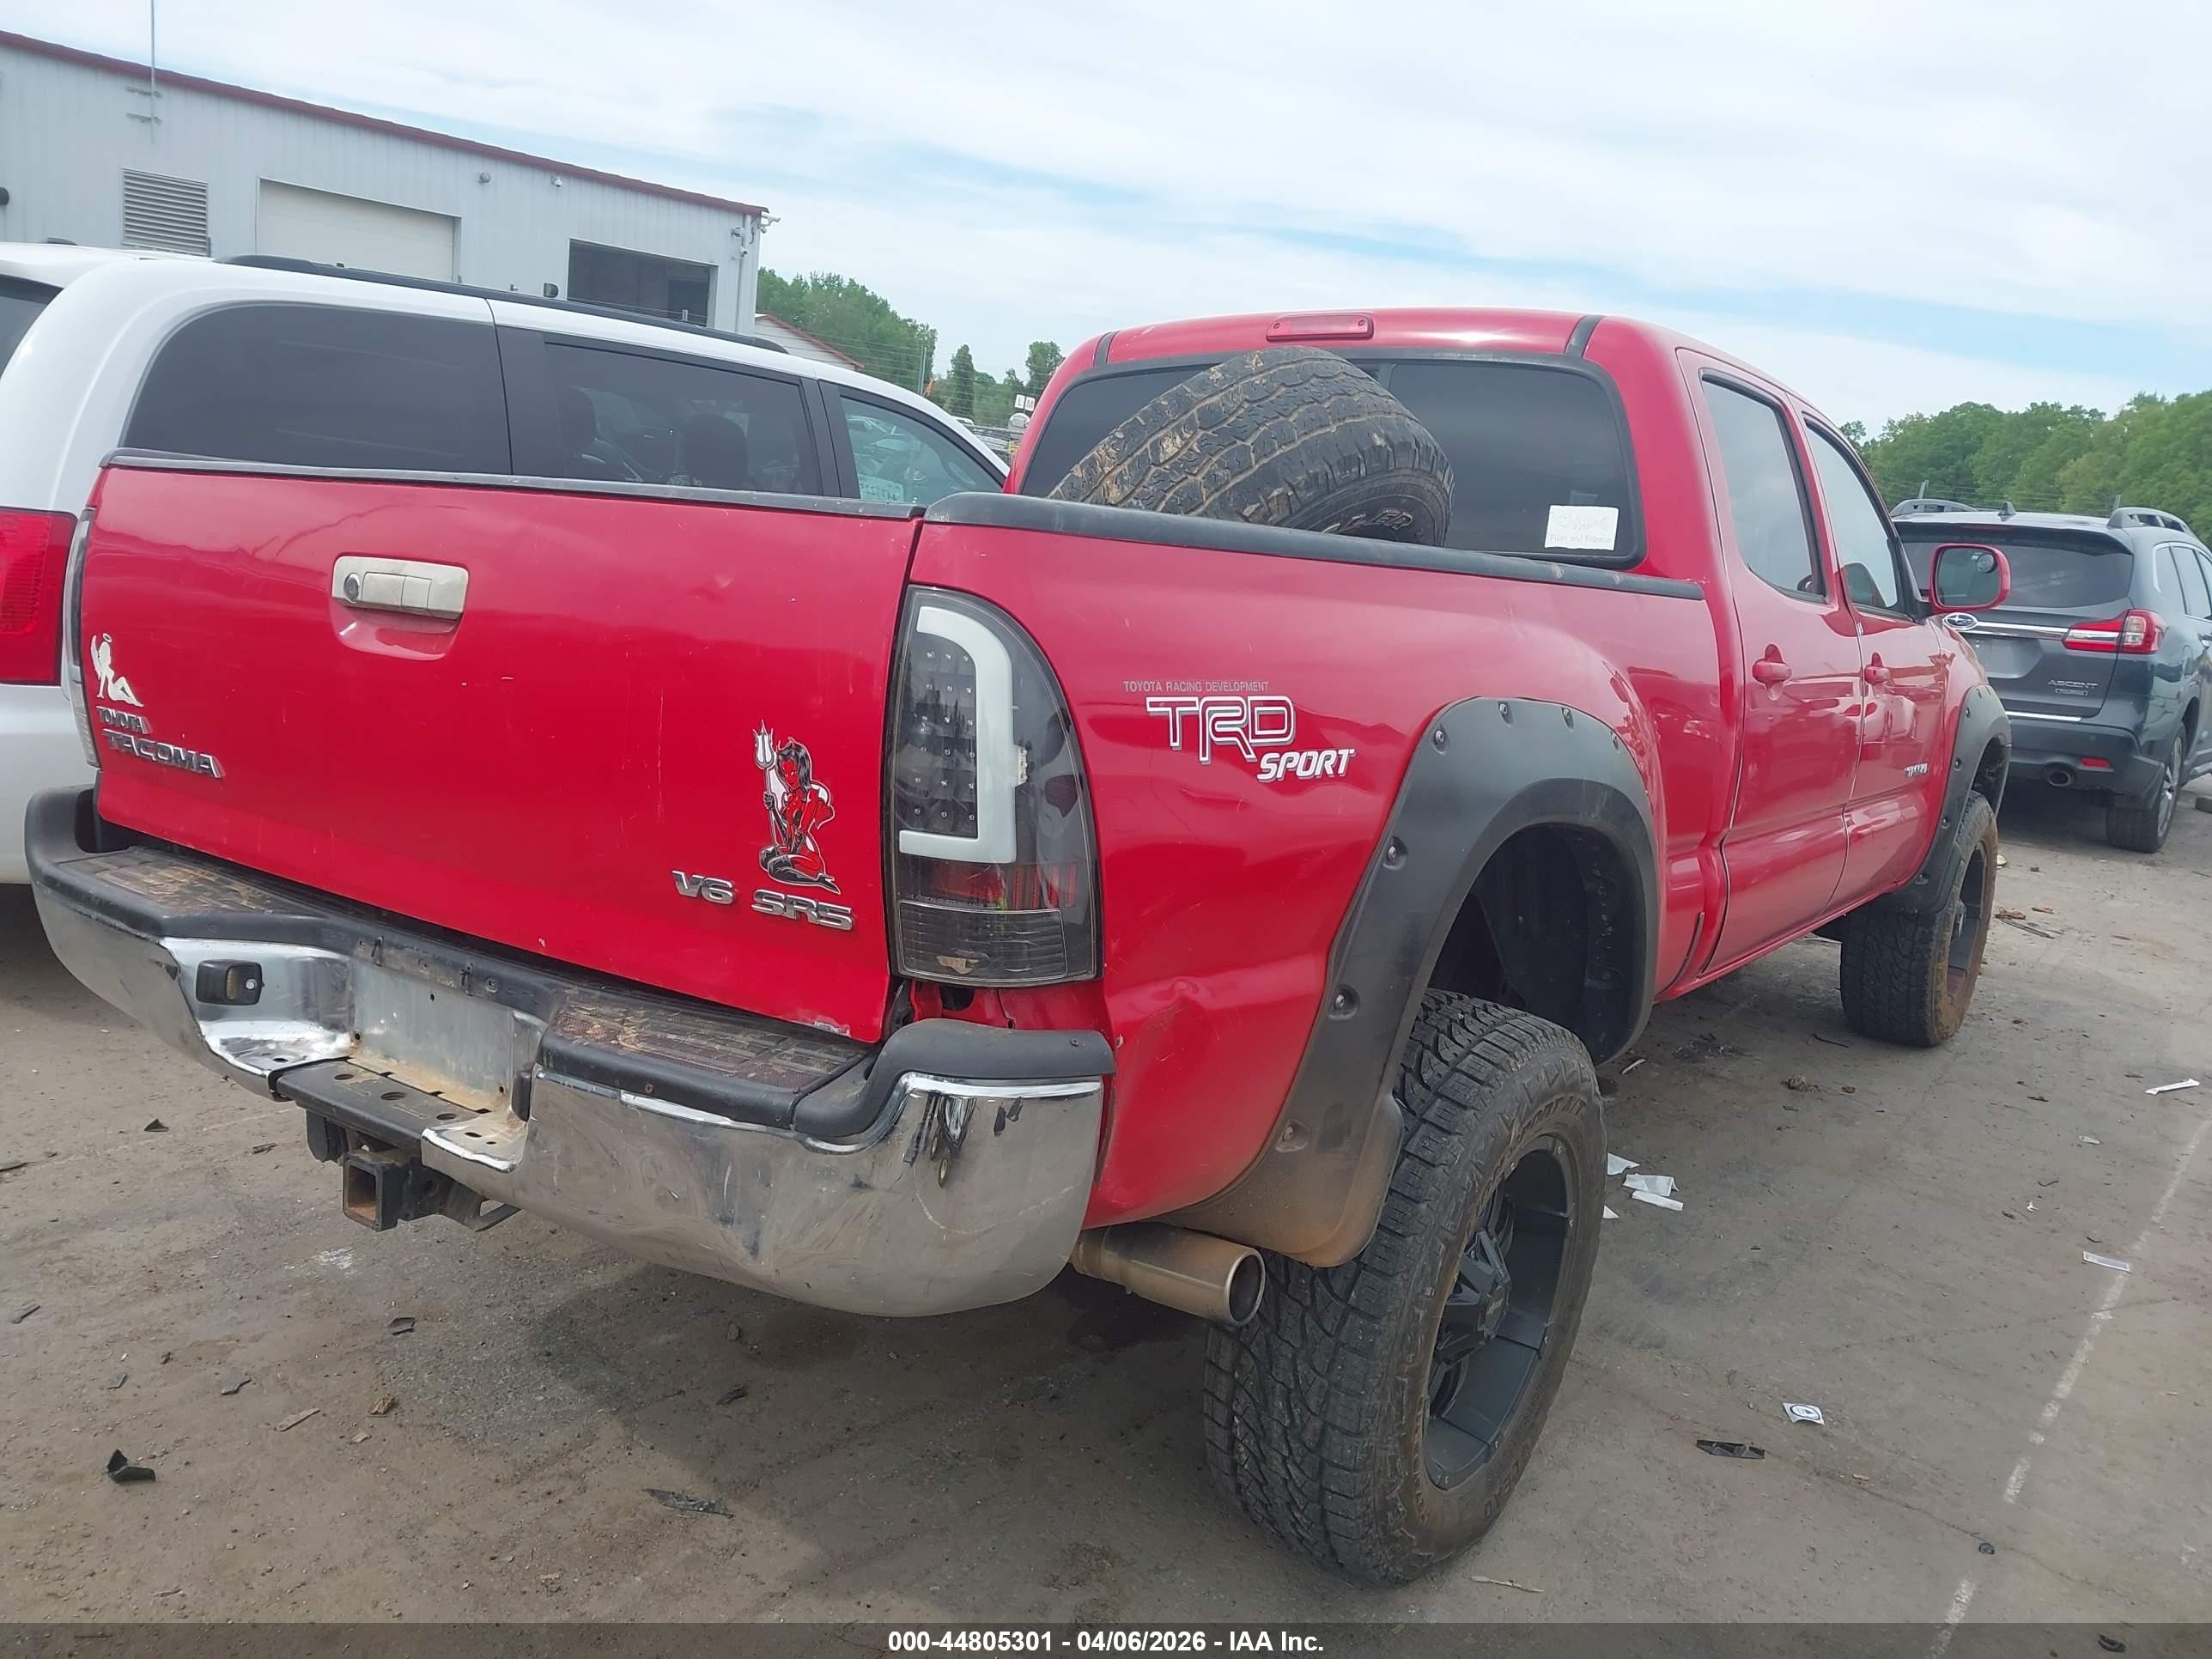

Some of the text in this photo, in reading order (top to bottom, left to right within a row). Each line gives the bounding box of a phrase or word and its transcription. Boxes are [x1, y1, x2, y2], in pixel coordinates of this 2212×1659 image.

[1123, 680, 1270, 693] TOYOTA RACING DEVELOPMENT
[95, 705, 150, 735] TOYOTA
[1146, 696, 1297, 764] TRD
[102, 728, 225, 779] TACOMA
[1257, 748, 1357, 784] SPORT
[672, 870, 854, 931] V6 SR5
